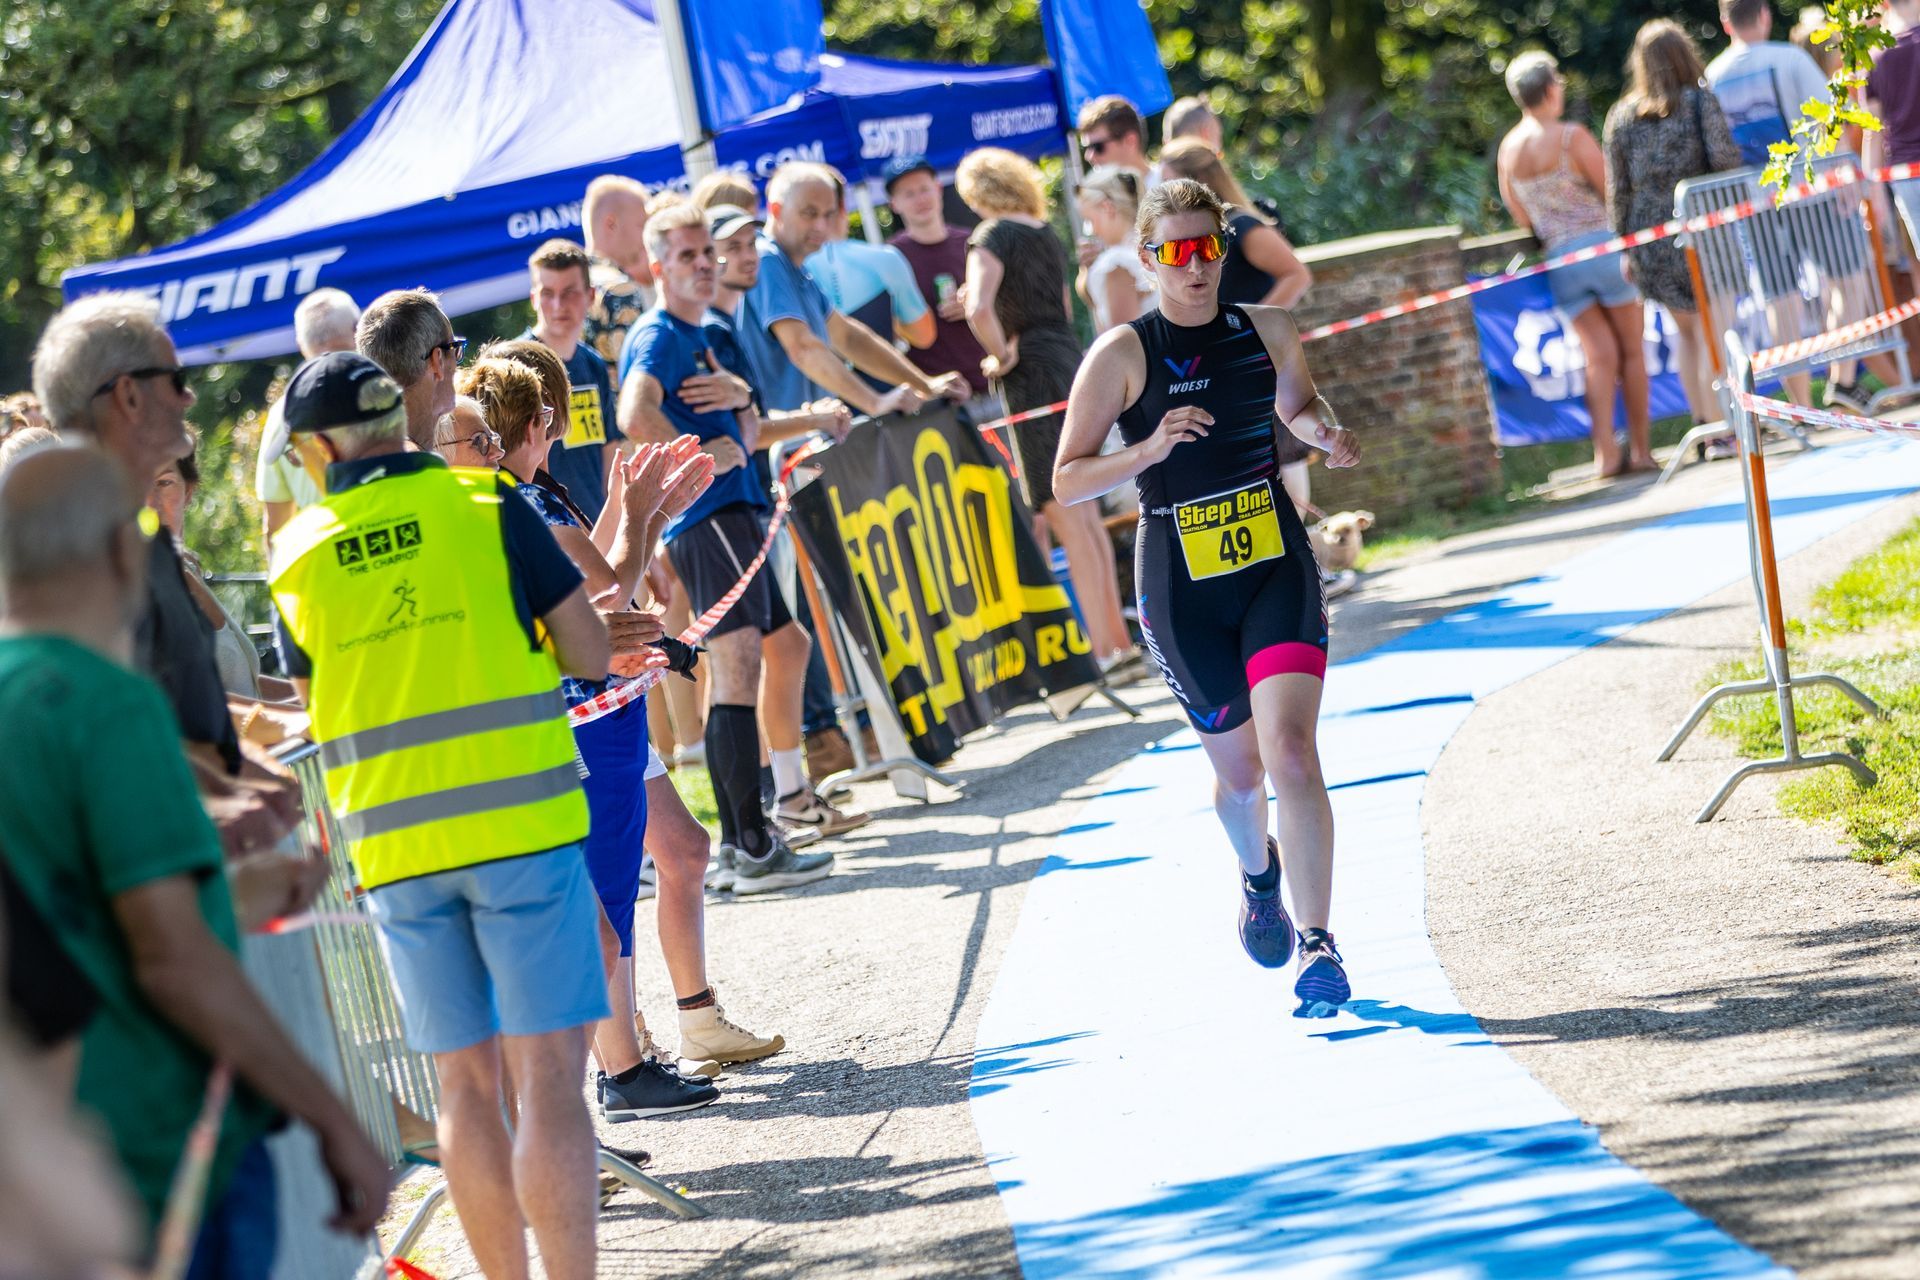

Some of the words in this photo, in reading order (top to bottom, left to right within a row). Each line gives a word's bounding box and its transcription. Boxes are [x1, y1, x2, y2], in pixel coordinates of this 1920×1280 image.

[148, 246, 347, 325] IANT
[1168, 378, 1210, 395] WOEST
[1179, 501, 1232, 527] Step
[1237, 489, 1271, 514] One
[1238, 512, 1252, 521] TRAIL
[1250, 509, 1261, 517] AND
[1260, 506, 1271, 514] RUN
[1181, 524, 1208, 534] TRIATHLON
[1219, 526, 1253, 566] 49
[347, 563, 368, 576] THE
[373, 548, 420, 570] CHARIOT
